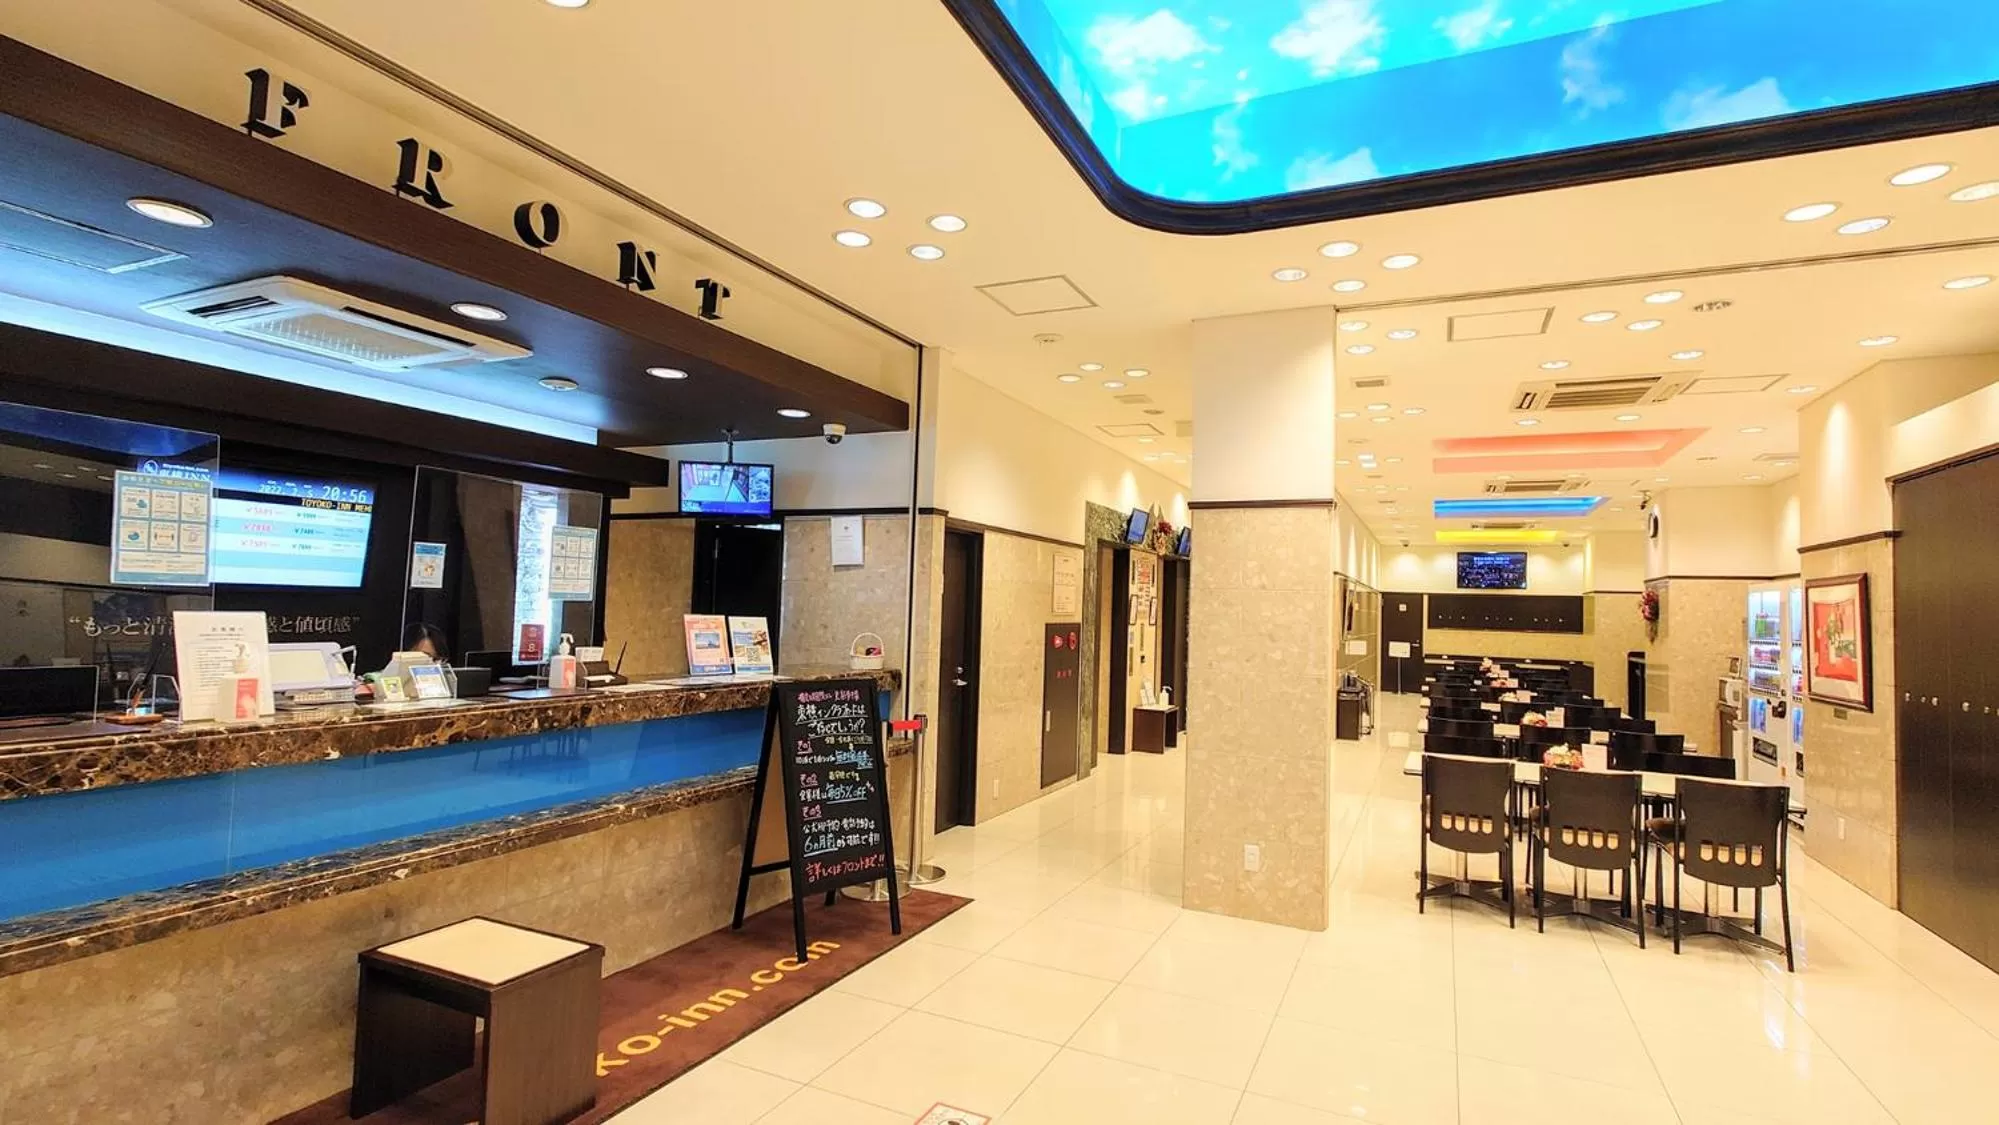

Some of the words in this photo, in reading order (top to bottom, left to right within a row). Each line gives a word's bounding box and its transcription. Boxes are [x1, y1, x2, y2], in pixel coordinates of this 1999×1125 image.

[243, 67, 731, 320] FRONT
[322, 485, 367, 504] 20:56
[68, 616, 174, 637] “もっと清
